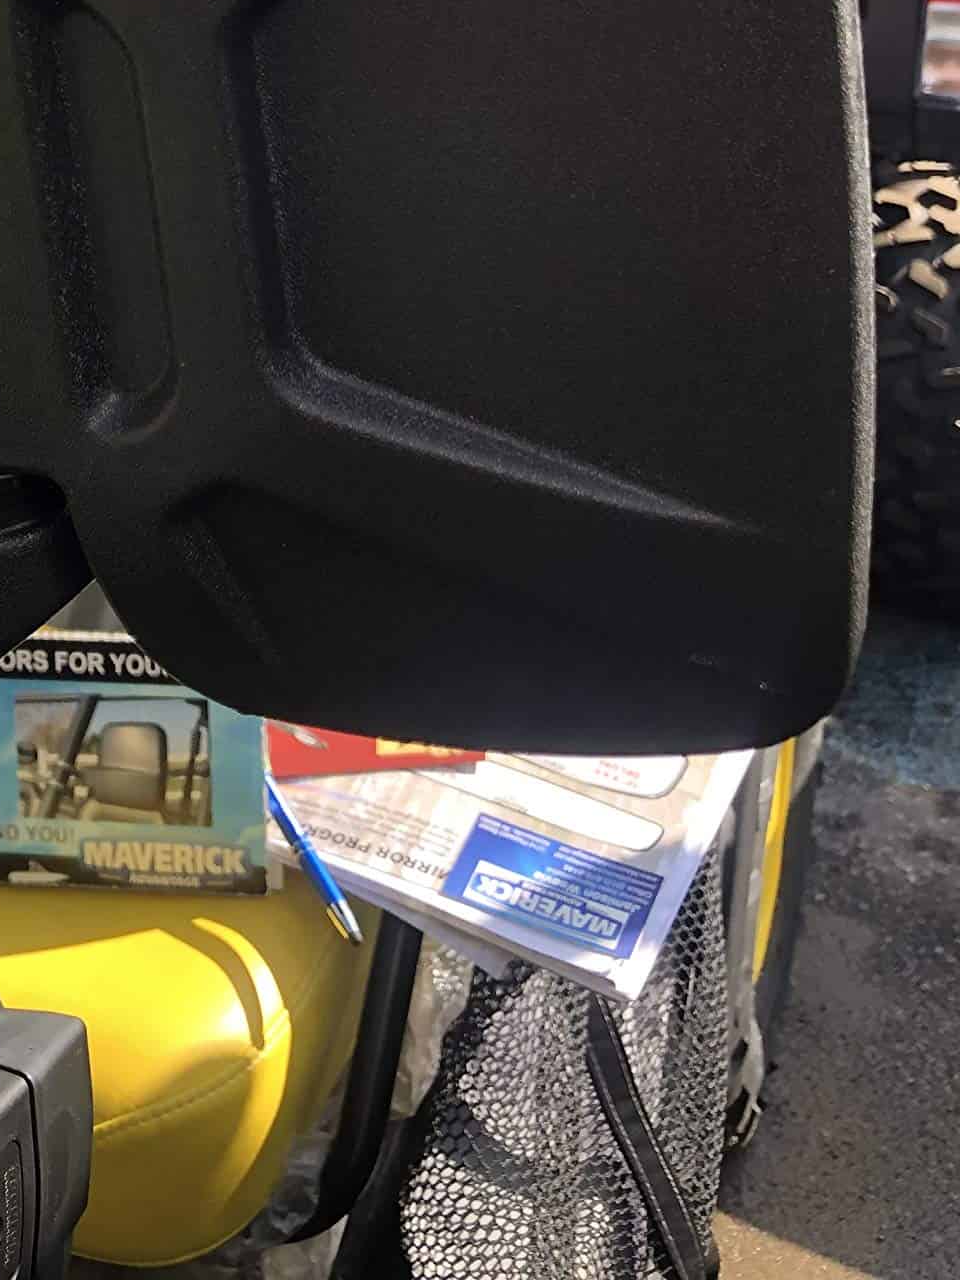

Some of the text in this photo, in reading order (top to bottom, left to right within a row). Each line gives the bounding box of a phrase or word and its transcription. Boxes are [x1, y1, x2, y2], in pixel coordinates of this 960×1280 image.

[54, 651, 105, 676] FOR
[109, 652, 168, 678] YOU
[24, 824, 78, 844] YOU!
[302, 822, 374, 854] PROGR
[82, 840, 246, 875] MAVERICK
[477, 873, 619, 937] MAVERICK
